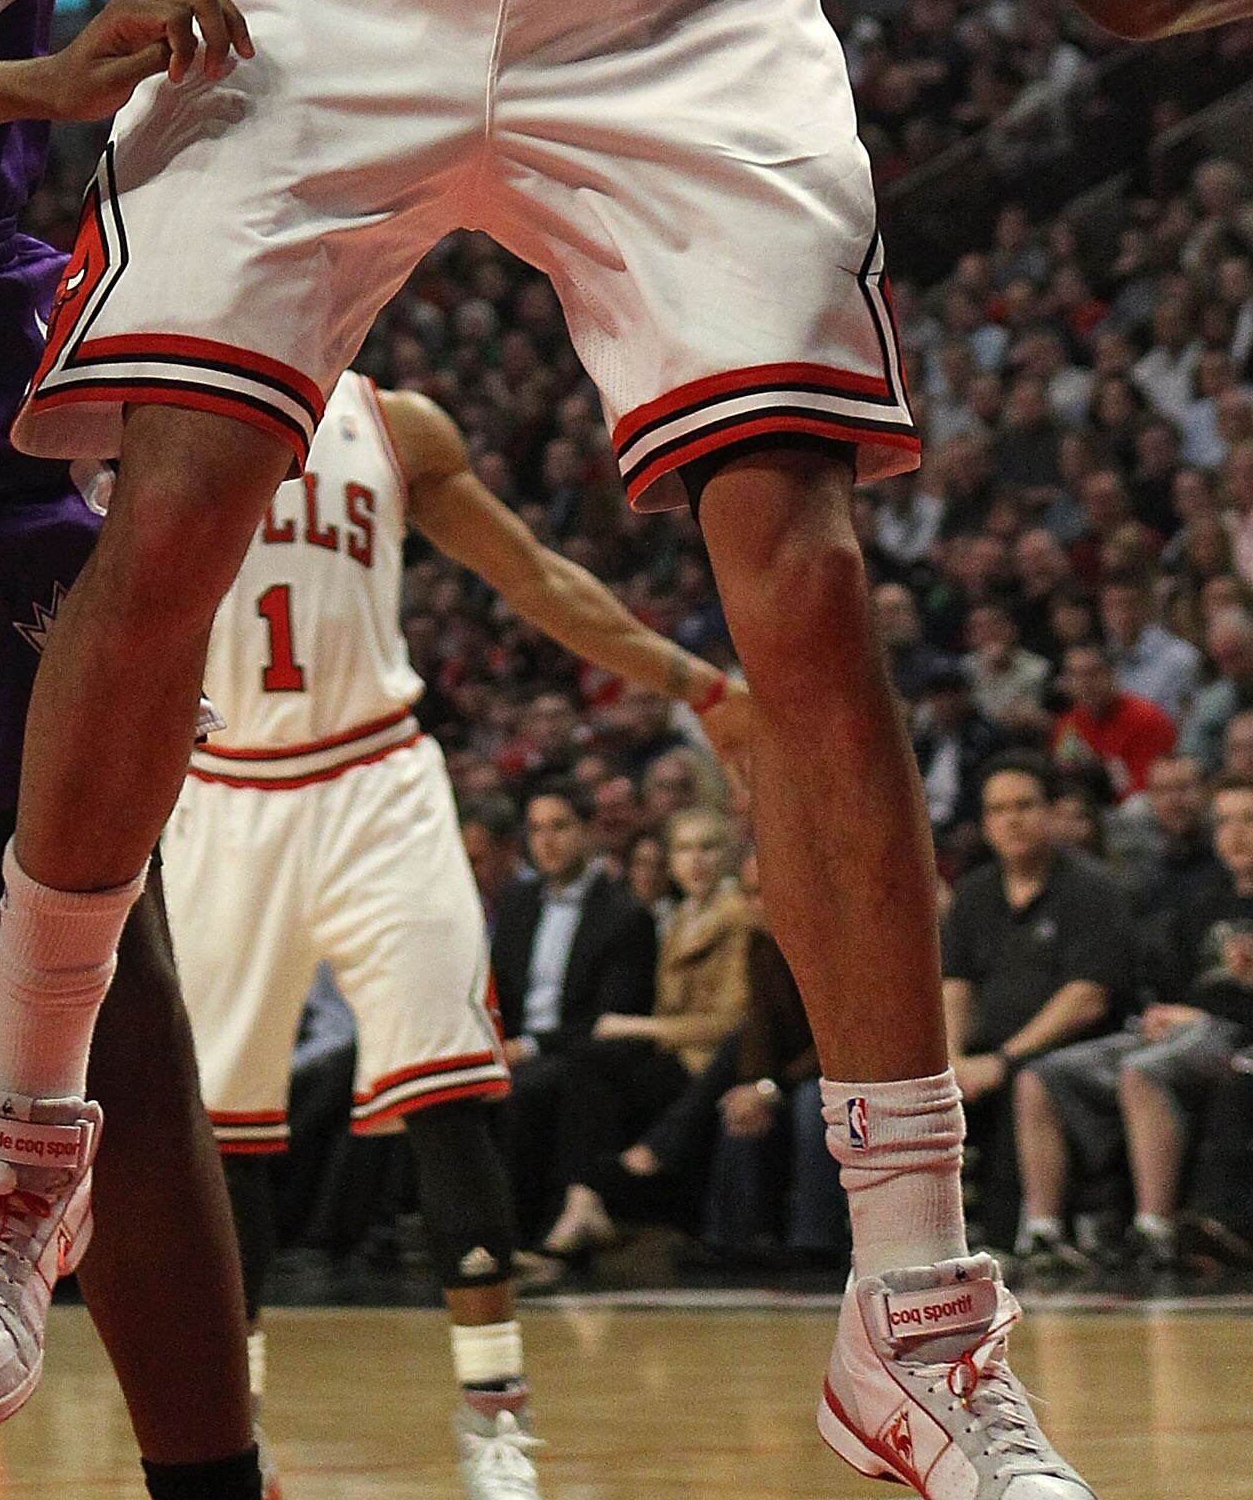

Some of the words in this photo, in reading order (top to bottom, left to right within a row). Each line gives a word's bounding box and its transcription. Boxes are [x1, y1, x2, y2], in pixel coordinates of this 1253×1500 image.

[257, 584, 305, 692] 1
[15, 1138, 45, 1158] coq
[890, 1308, 922, 1325] coq
[923, 1294, 973, 1322] sportif
